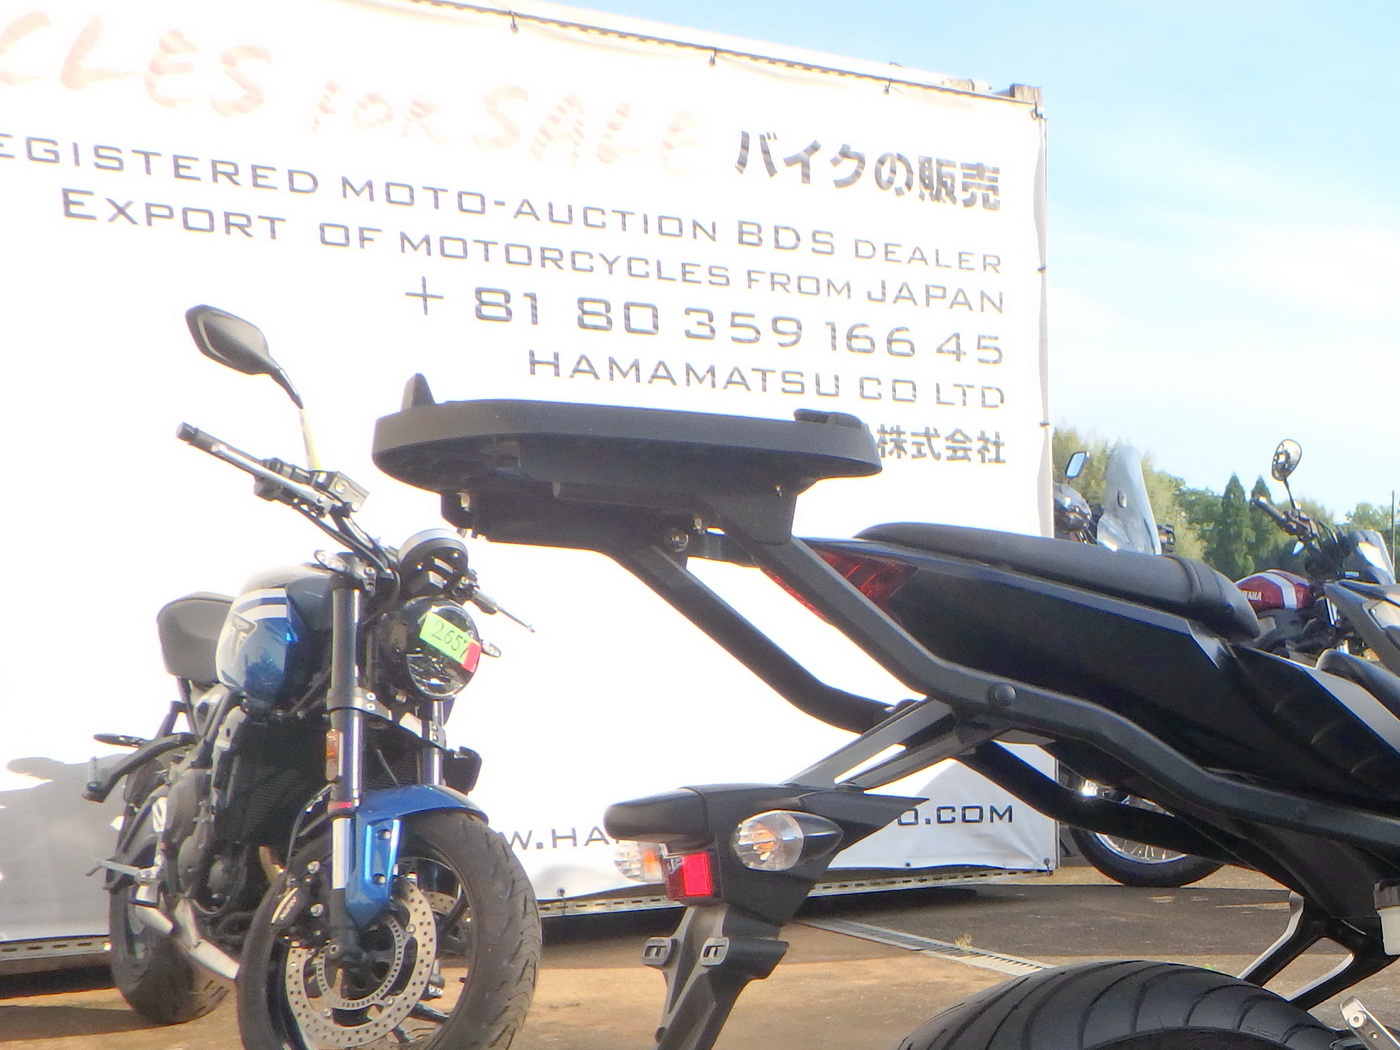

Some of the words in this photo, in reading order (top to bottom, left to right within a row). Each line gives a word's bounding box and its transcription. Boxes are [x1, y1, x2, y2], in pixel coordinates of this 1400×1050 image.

[474, 84, 704, 176] SALE
[734, 130, 1001, 211] バイクの販売
[61, 187, 287, 240] EXPORT
[319, 222, 383, 250] OF
[400, 231, 731, 287] MOTORCYCLES
[746, 269, 852, 300] FROM
[866, 279, 1004, 314] JAPAN
[341, 176, 717, 242] MOTO-AUCTION
[737, 220, 836, 256] BDS
[854, 239, 1002, 274] DEALER
[474, 286, 539, 326] 81
[576, 296, 660, 336] 80
[684, 307, 803, 348] 359
[824, 321, 916, 358] 166
[935, 332, 1004, 365] 45
[528, 349, 840, 398] HAMAMATSU
[858, 376, 917, 403] CO
[935, 382, 1005, 408] LTD
[876, 423, 1007, 465] 株式会社
[498, 825, 620, 851] W.HA
